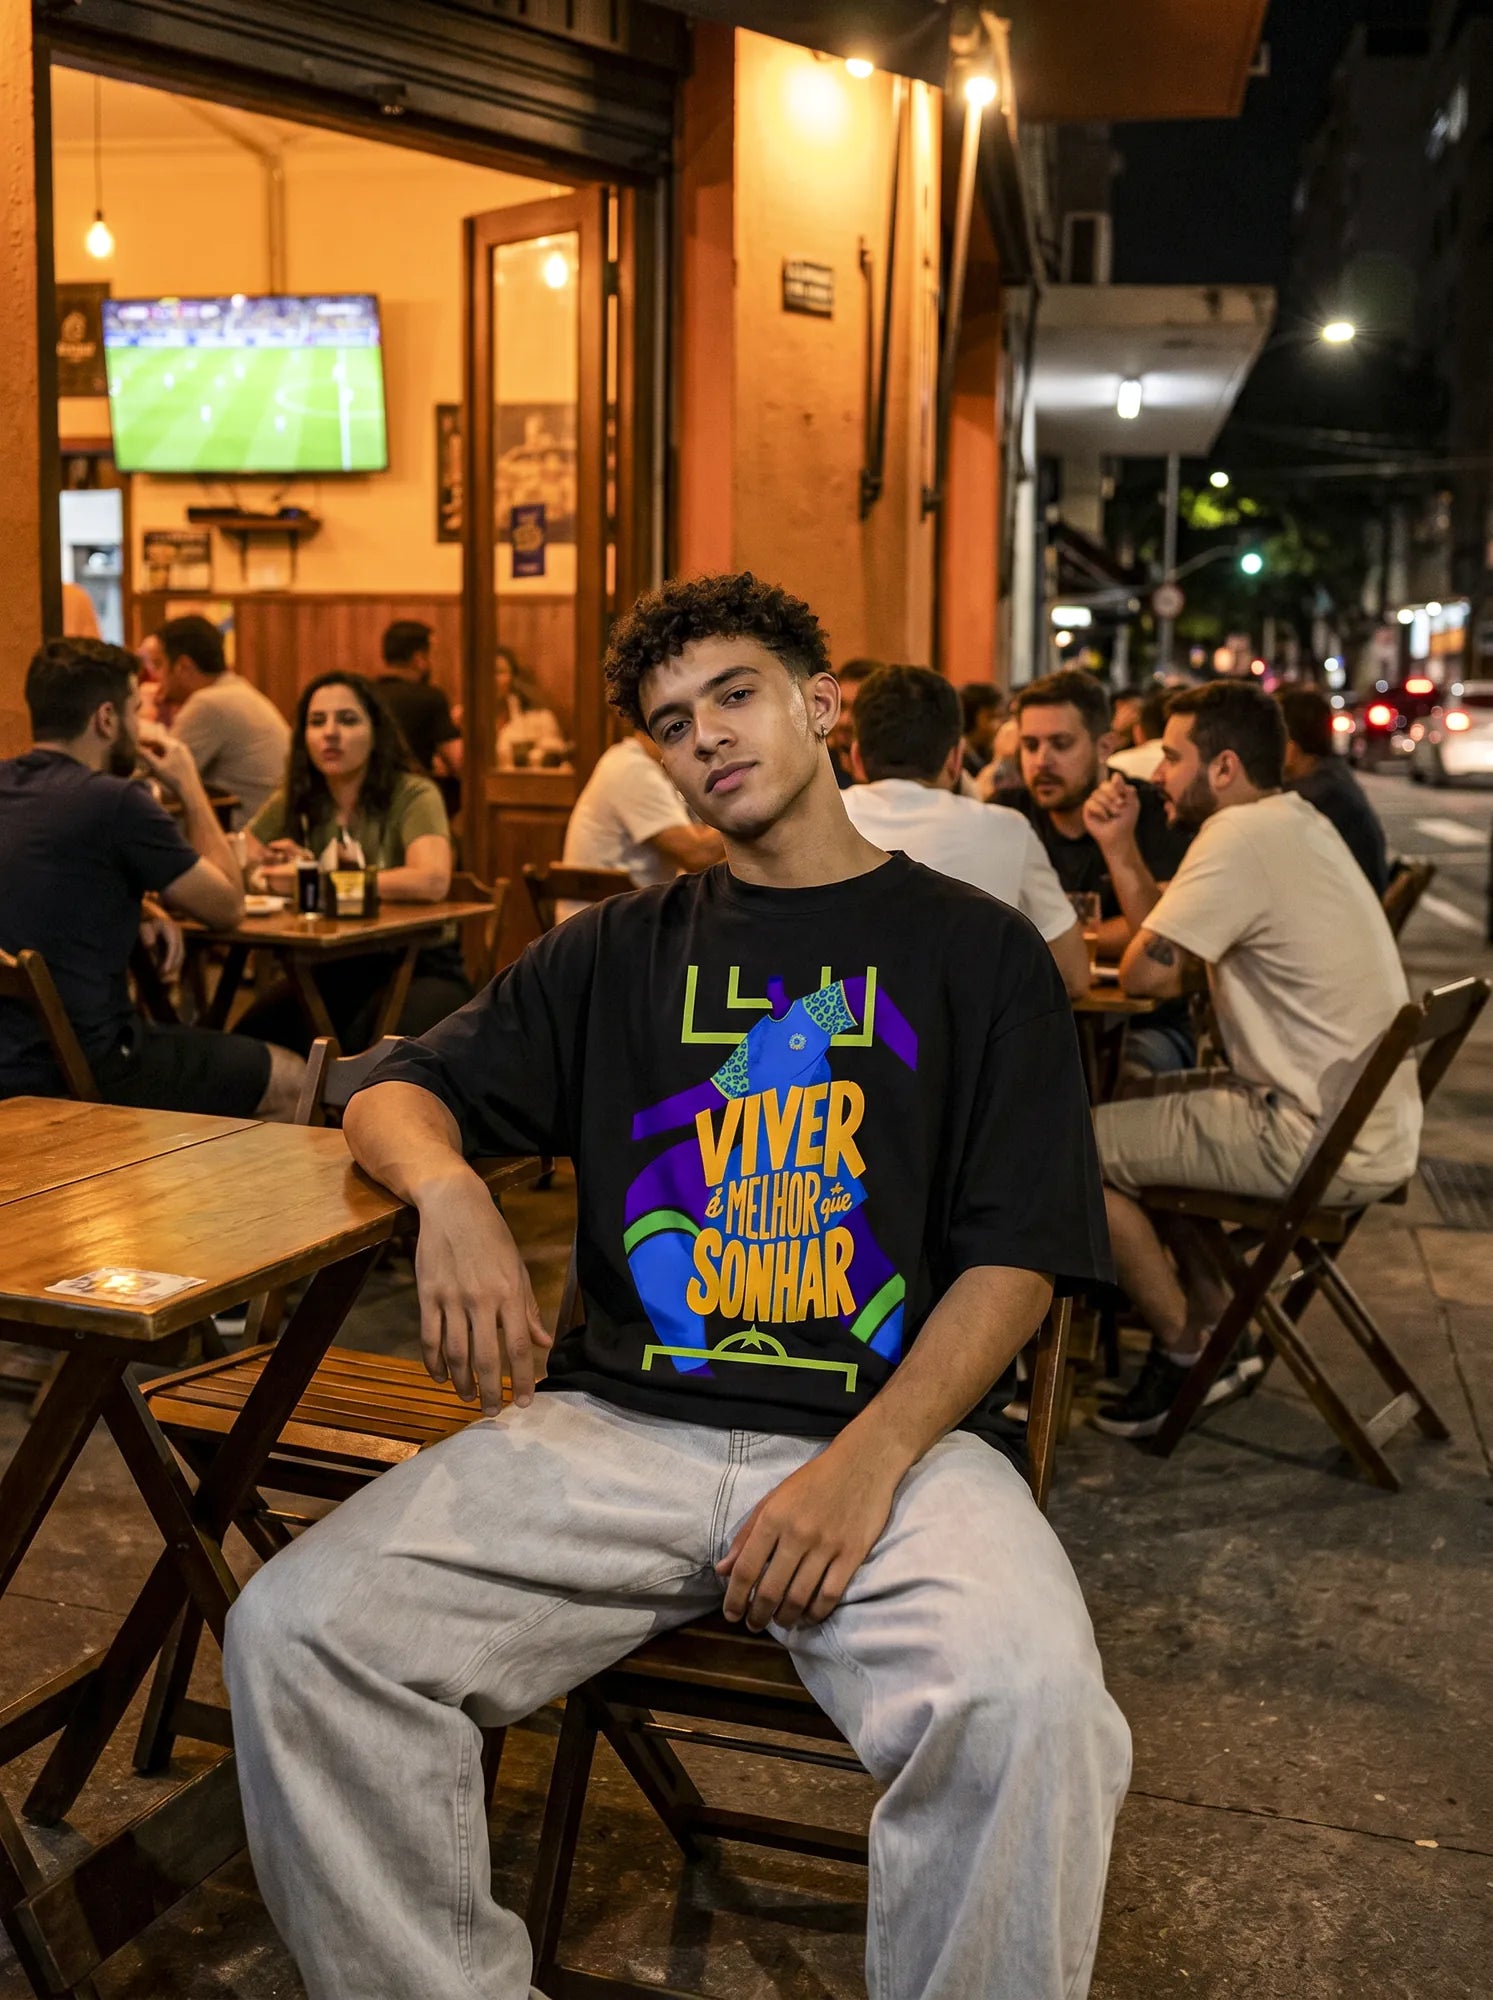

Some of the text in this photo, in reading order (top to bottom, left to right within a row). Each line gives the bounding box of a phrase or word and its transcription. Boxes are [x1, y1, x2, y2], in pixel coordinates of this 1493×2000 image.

[695, 1080, 867, 1187] VIVER
[705, 1171, 853, 1240] é MELHOR que
[686, 1226, 857, 1324] SONHAR
